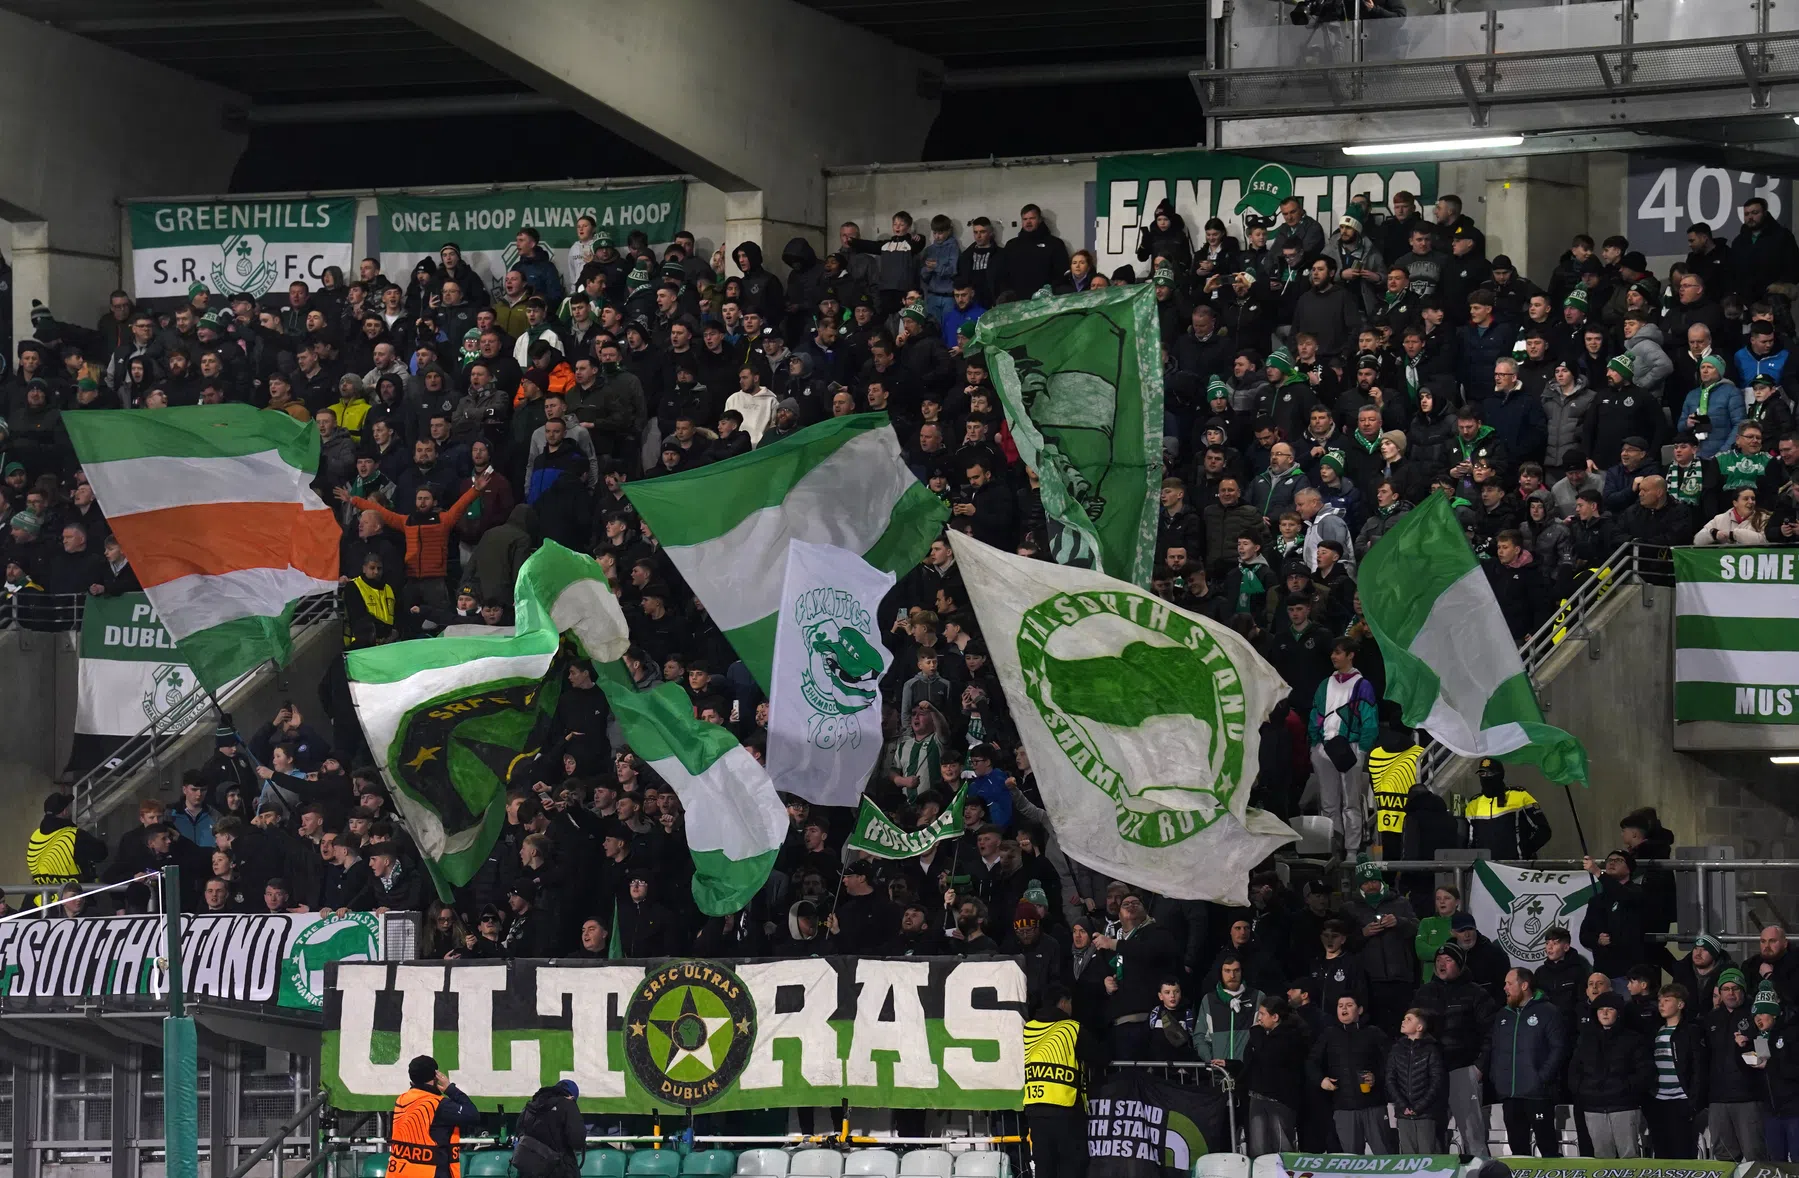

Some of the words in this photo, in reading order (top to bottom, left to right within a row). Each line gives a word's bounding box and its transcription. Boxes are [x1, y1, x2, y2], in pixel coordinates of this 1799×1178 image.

[155, 204, 331, 232] GREENHILLS
[391, 212, 442, 233] ONCE
[447, 211, 461, 231] A
[464, 208, 516, 230] HOOP
[521, 206, 597, 228] ALWAYS
[602, 206, 615, 226] A
[619, 202, 671, 225] HOOP
[153, 257, 206, 285] S.R.
[1720, 554, 1799, 581] SOME
[104, 625, 178, 649] DUBL
[1054, 593, 1171, 634] SOUTH
[1184, 625, 1245, 742] STAND
[805, 687, 837, 713] SHAMROC
[807, 712, 862, 752] 1899
[1382, 813, 1400, 828] 67
[1517, 871, 1571, 885] SRFC
[296, 925, 319, 946] THE
[1500, 930, 1530, 960] SHAMROCK
[8, 918, 162, 997] SOUTH
[291, 972, 324, 1007] SHAMRO
[643, 968, 679, 1001] SRFC
[684, 965, 740, 999] ULTRAS
[336, 957, 1028, 1097] ULTRAS
[1024, 1064, 1075, 1083] TEWARD
[661, 1079, 719, 1100] DUBLIN
[1026, 1084, 1044, 1099] 135
[1115, 1099, 1163, 1125] STAND
[391, 1143, 433, 1162] WARD
[1294, 1157, 1324, 1169] ITS
[1325, 1157, 1392, 1171] FRIDAY
[1391, 1157, 1433, 1171] AND
